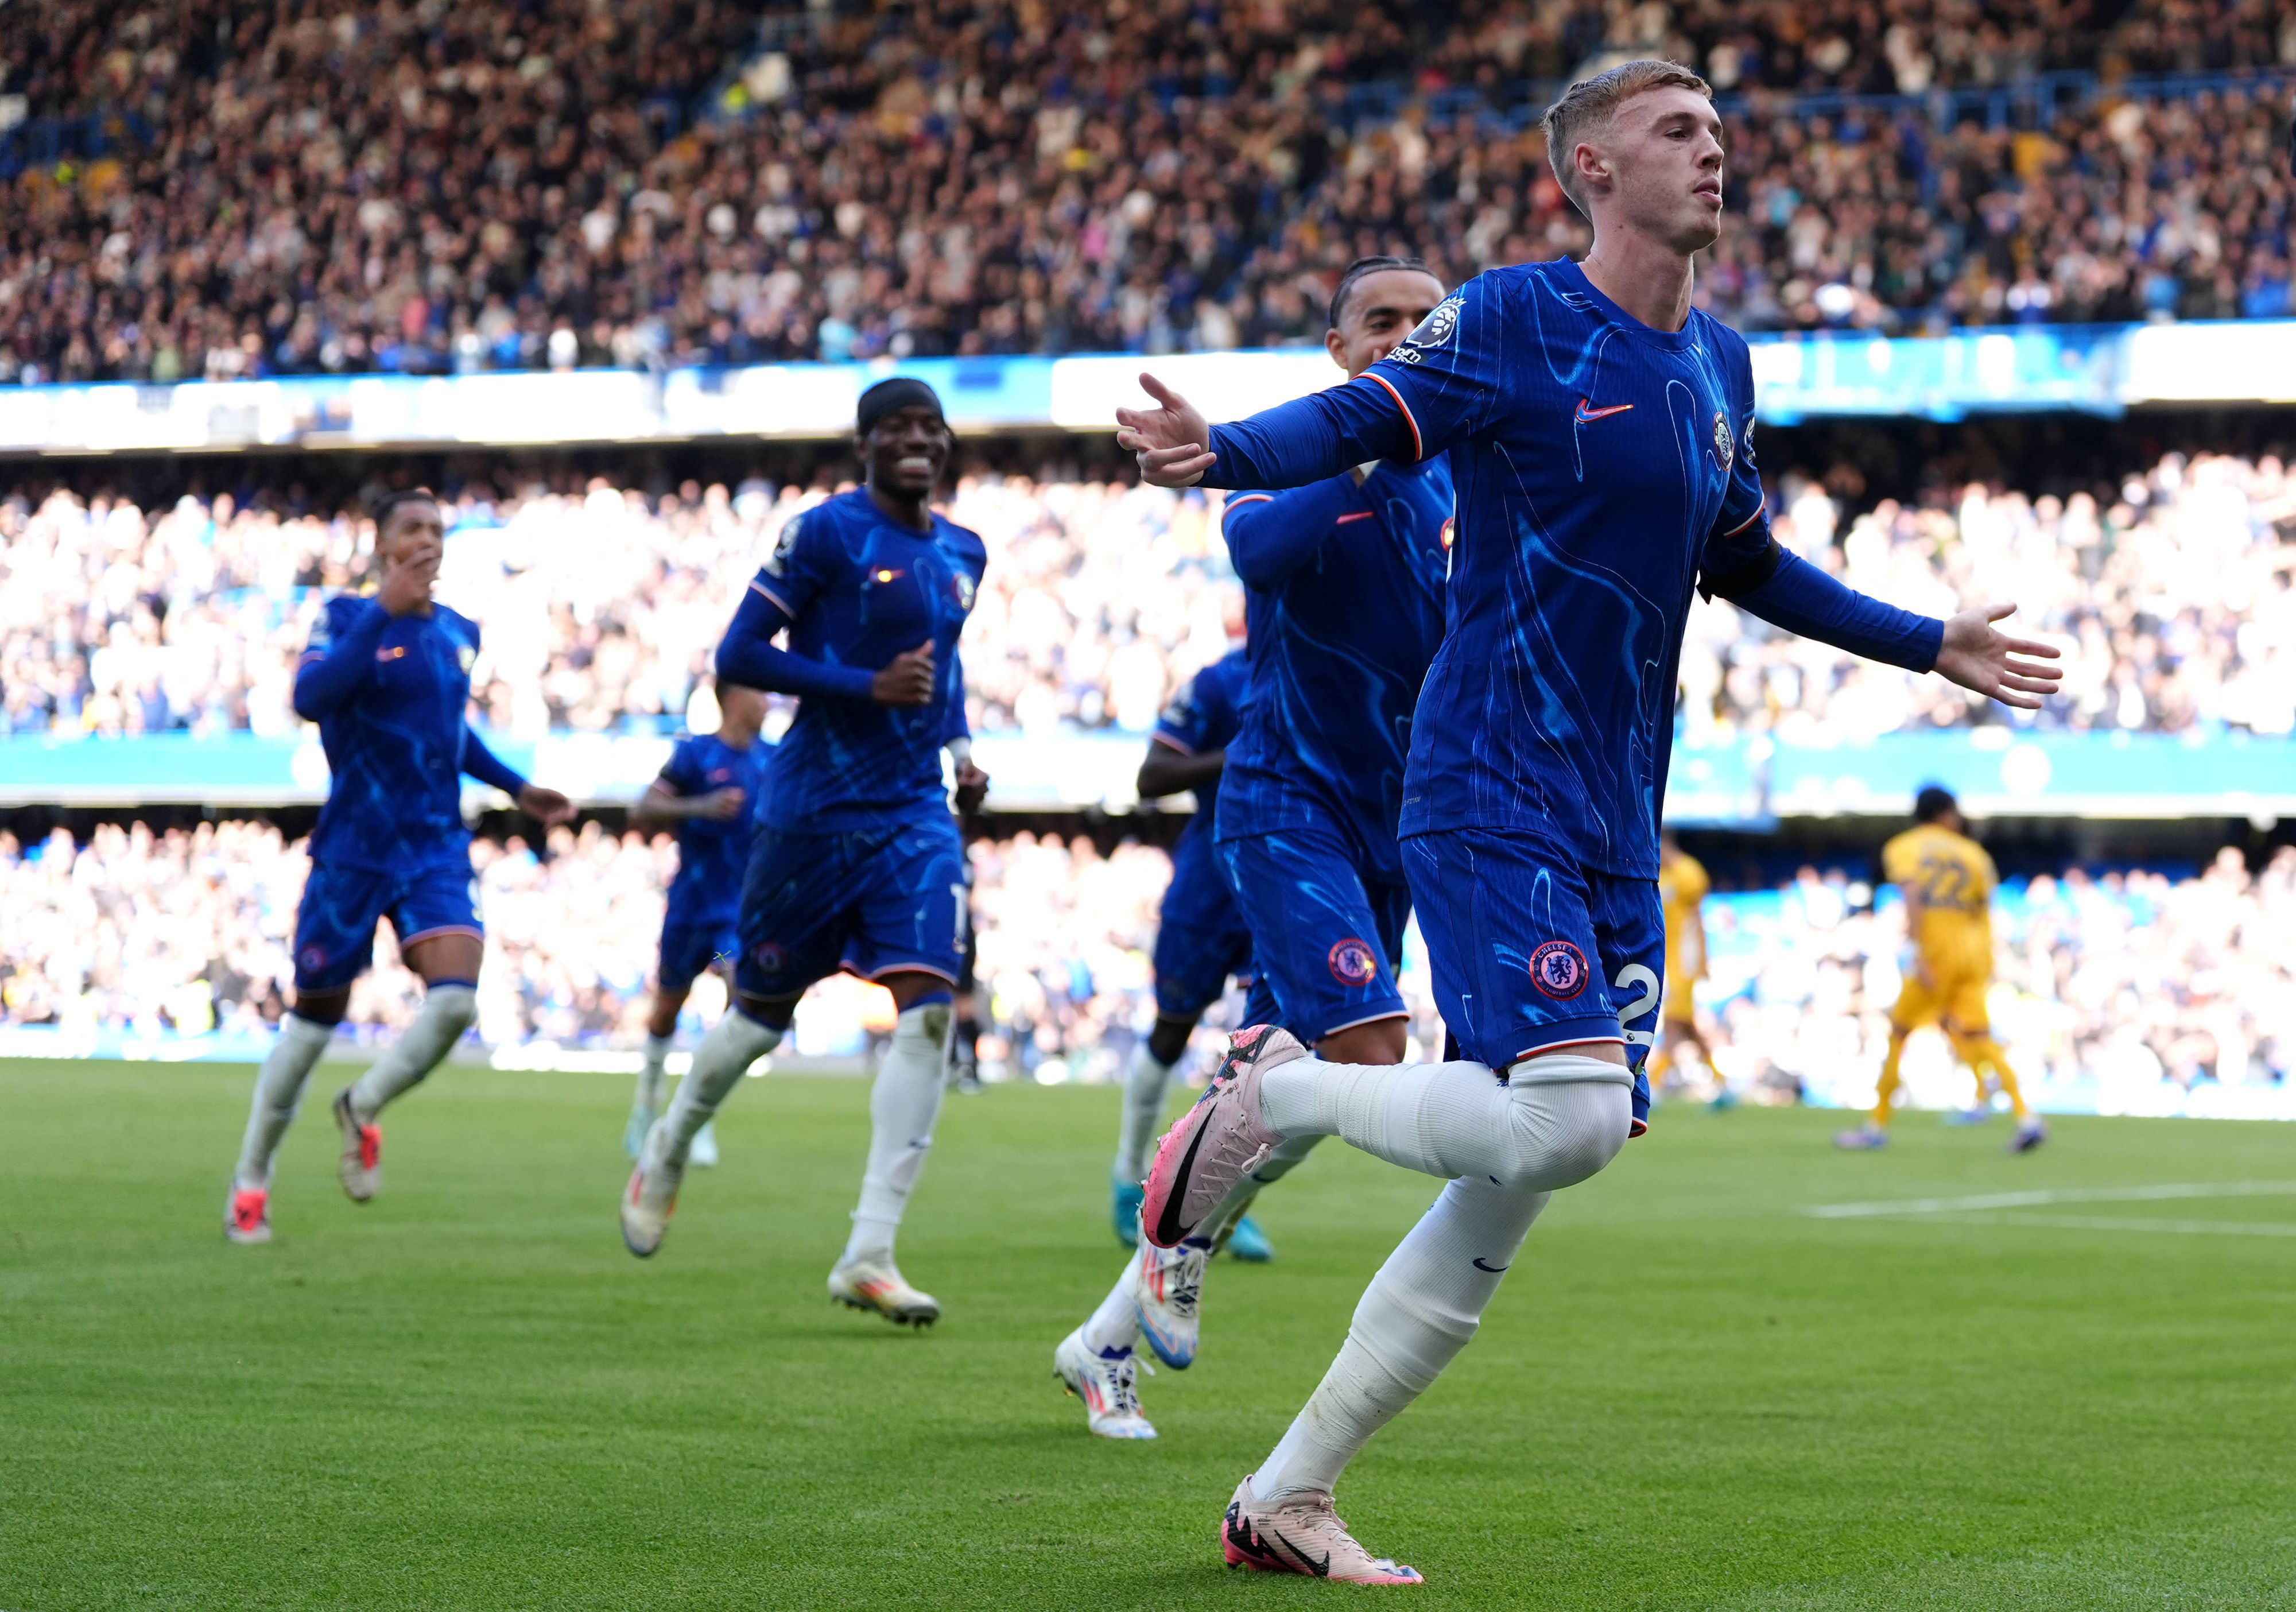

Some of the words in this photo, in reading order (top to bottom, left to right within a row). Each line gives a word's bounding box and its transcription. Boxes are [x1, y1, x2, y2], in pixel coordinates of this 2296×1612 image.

[1918, 857, 1973, 909] 22
[1538, 943, 1573, 958] CHELSEA
[1615, 963, 1660, 1049] 2
